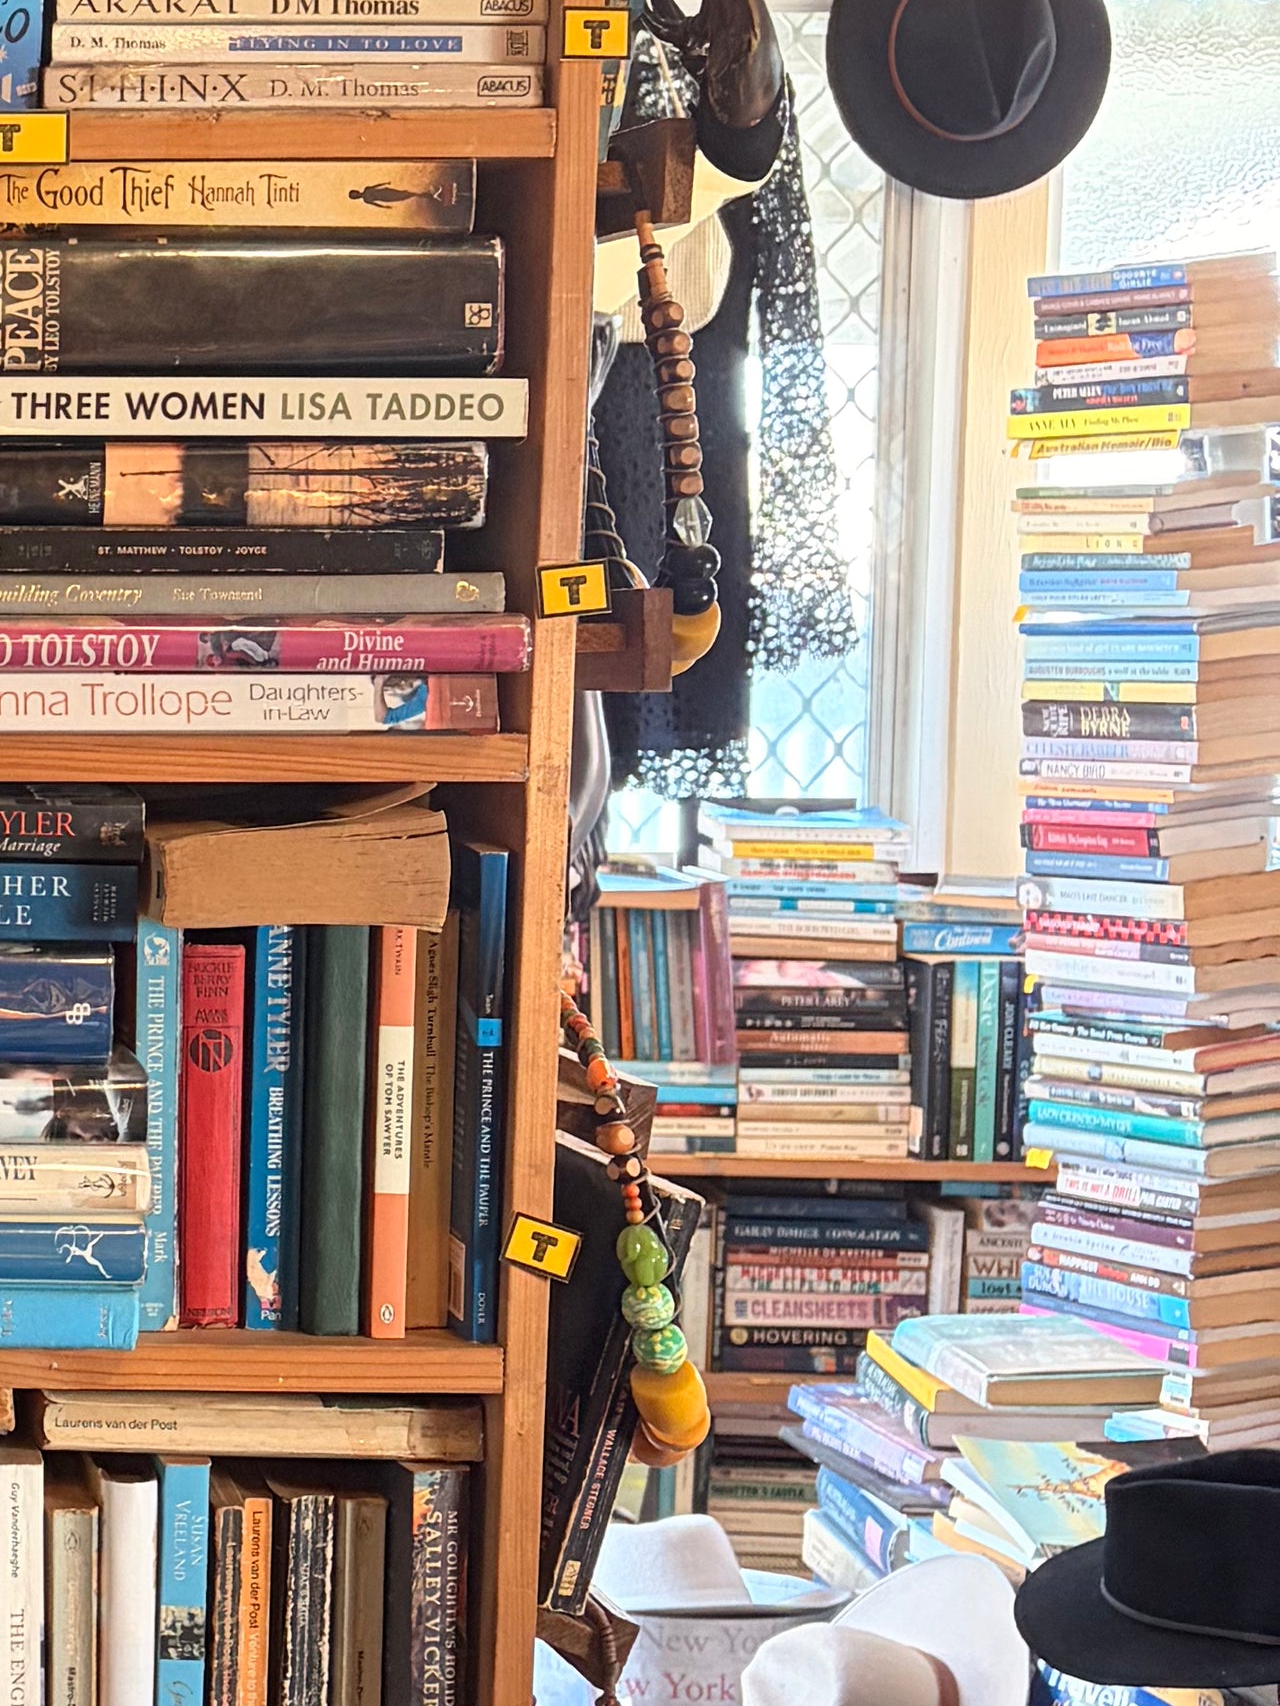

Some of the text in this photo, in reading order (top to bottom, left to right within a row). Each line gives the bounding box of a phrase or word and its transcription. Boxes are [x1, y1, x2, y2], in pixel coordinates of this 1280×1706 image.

[585, 20, 611, 48] T
[11, 389, 505, 422] THREE WOMEN LISA TADDEO
[1037, 439, 1098, 454] Australian
[560, 577, 587, 604] T
[79, 684, 232, 725] Trollope
[528, 1234, 558, 1262] T
[751, 1298, 873, 1320] CLEANSHEETS
[752, 1331, 847, 1346] HOVERING
